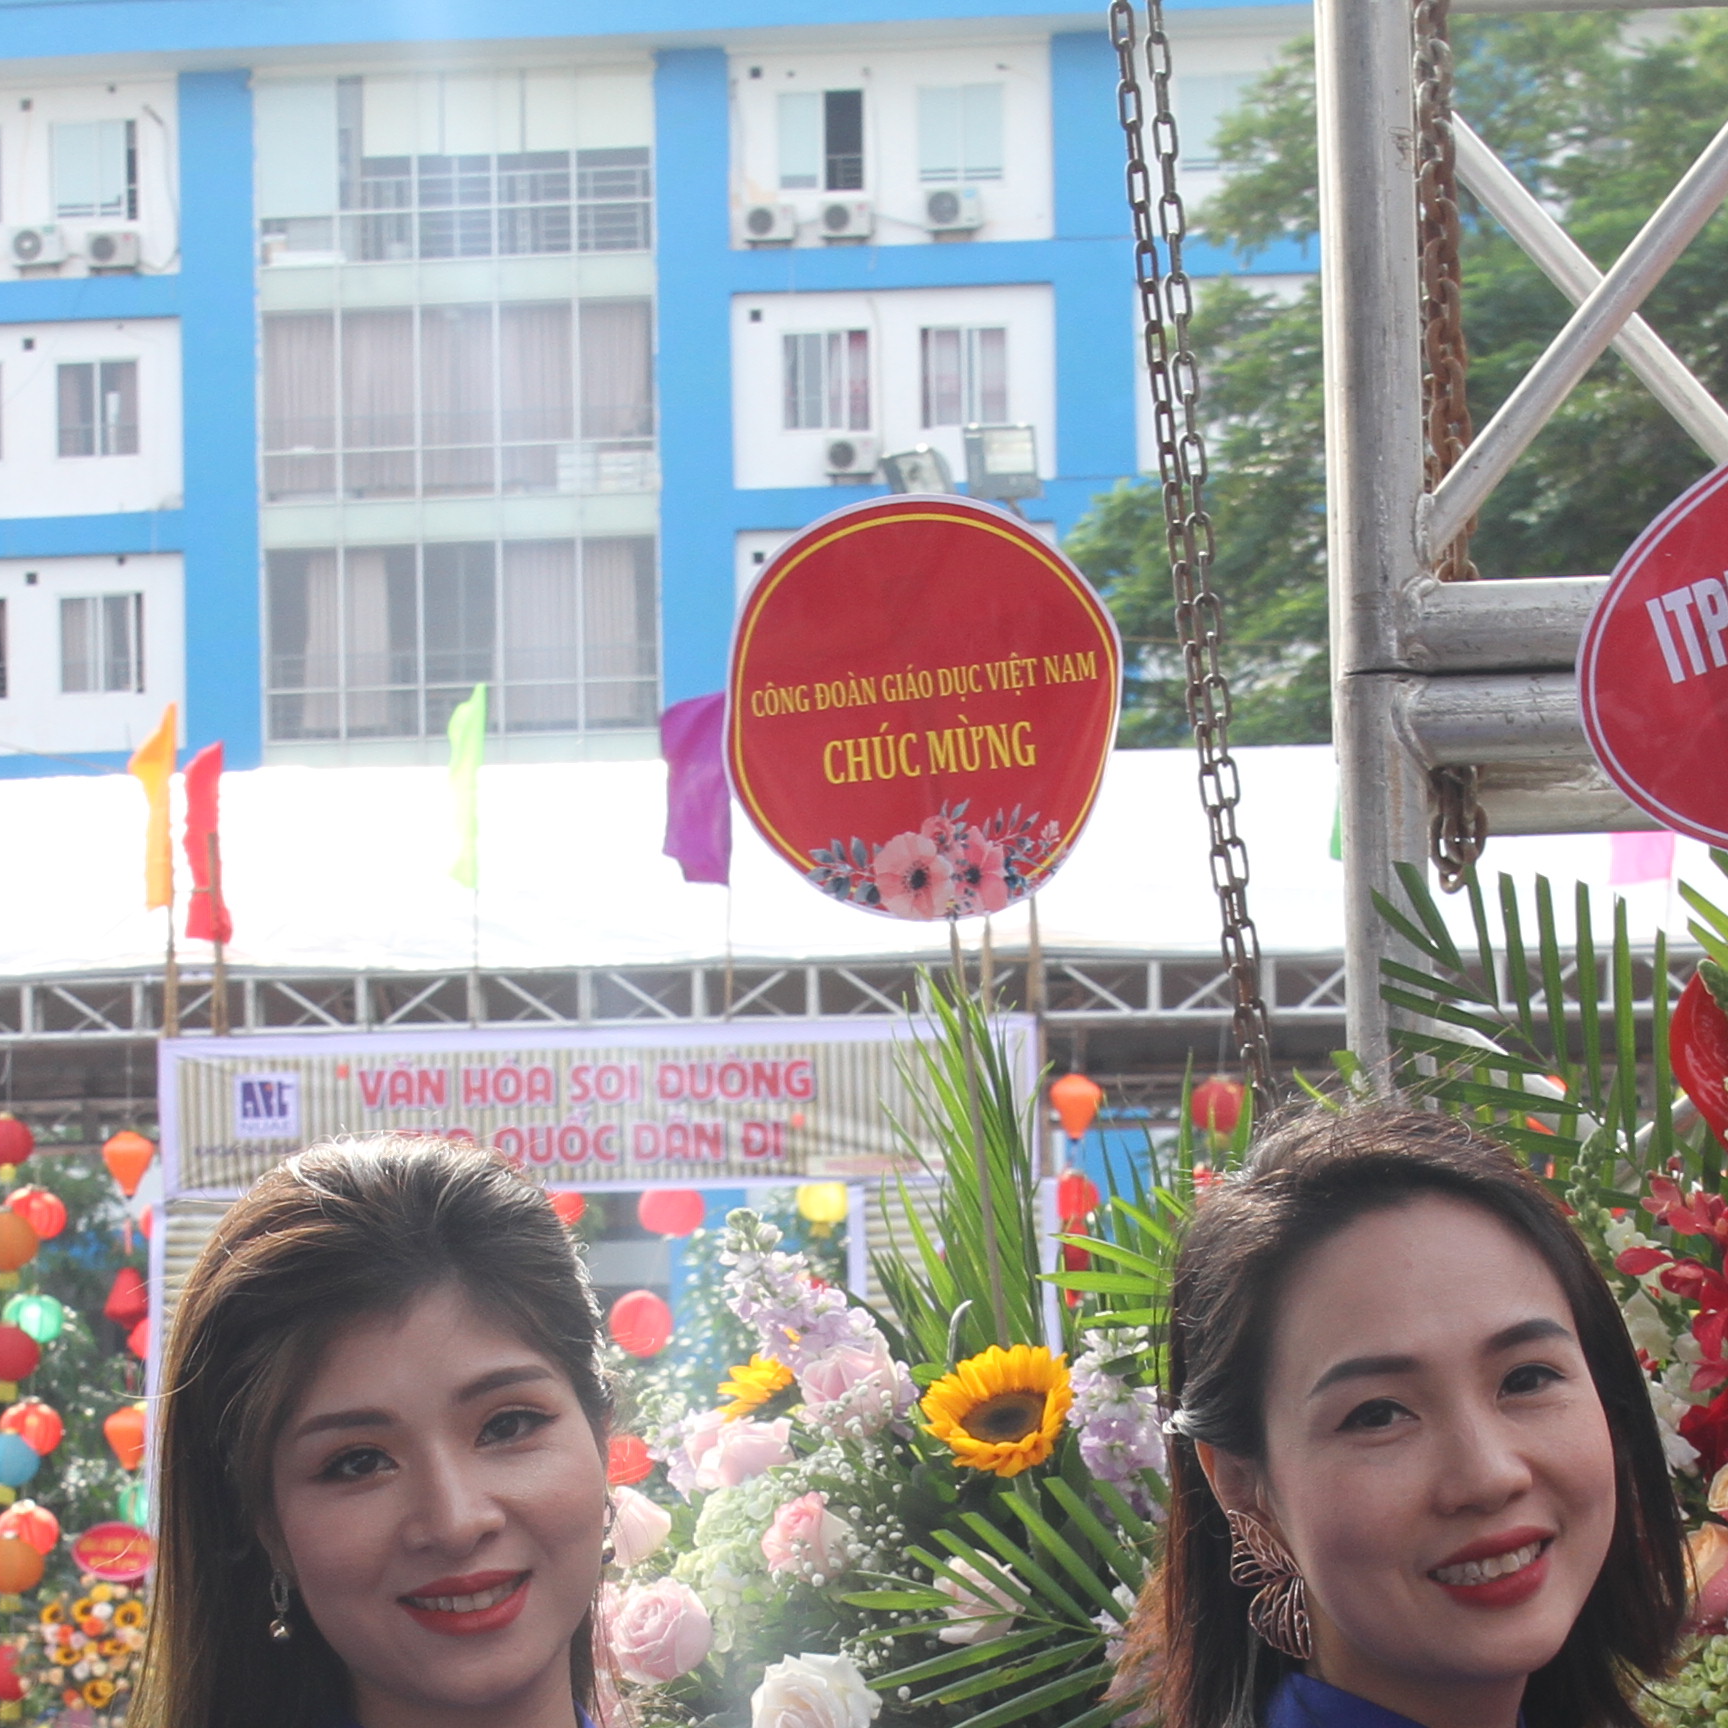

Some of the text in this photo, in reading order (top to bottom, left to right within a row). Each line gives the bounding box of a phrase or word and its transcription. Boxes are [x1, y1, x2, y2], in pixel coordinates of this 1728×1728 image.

[750, 650, 1098, 719] CÔNG ĐOÀN GIÁO DỤC VIỆT NAM
[823, 714, 1037, 785] CHÚC MỪNG
[571, 1063, 640, 1103] SOI
[742, 1119, 783, 1158] ĐI
